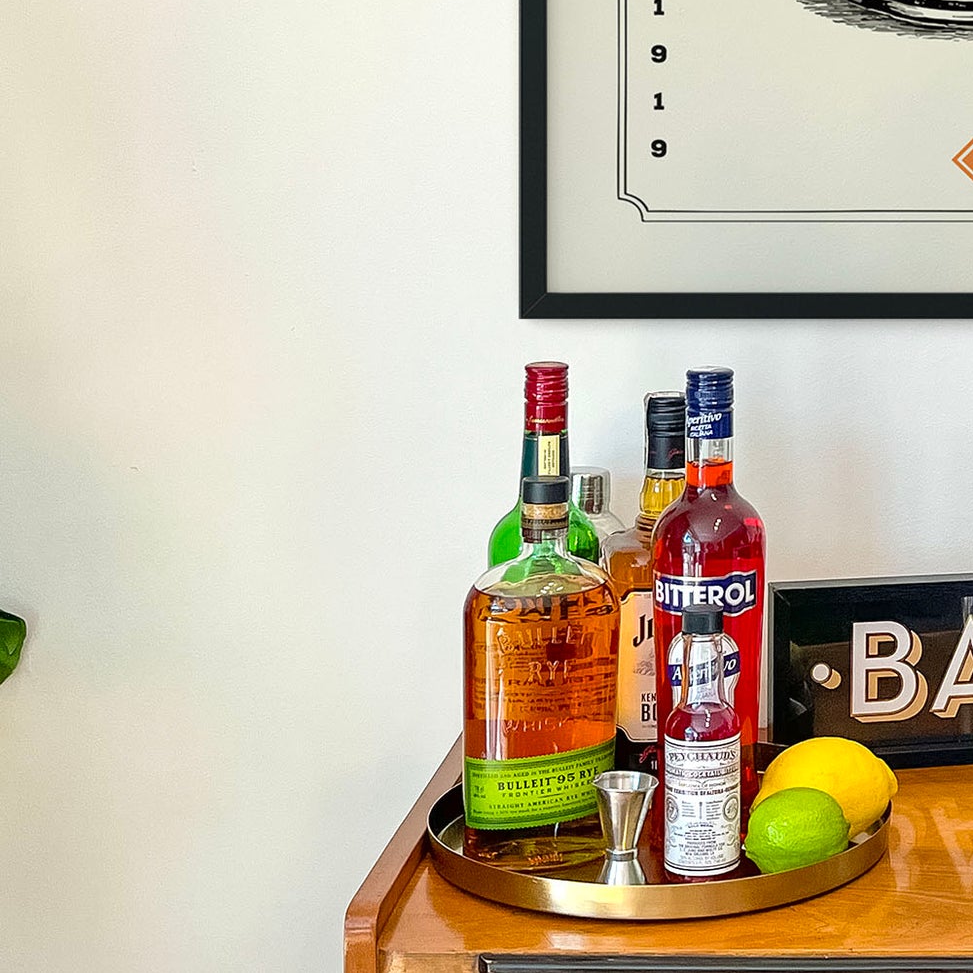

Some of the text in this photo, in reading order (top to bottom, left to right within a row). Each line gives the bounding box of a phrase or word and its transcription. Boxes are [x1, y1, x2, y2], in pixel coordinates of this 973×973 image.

[687, 412, 722, 427] peritivo
[655, 579, 755, 607] BITTEROL
[497, 777, 553, 791] BULLEIT
[557, 772, 576, 785] 95
[579, 765, 600, 779] RYE
[502, 787, 553, 798] FRONTIER
[527, 797, 564, 807] AMERICAN
